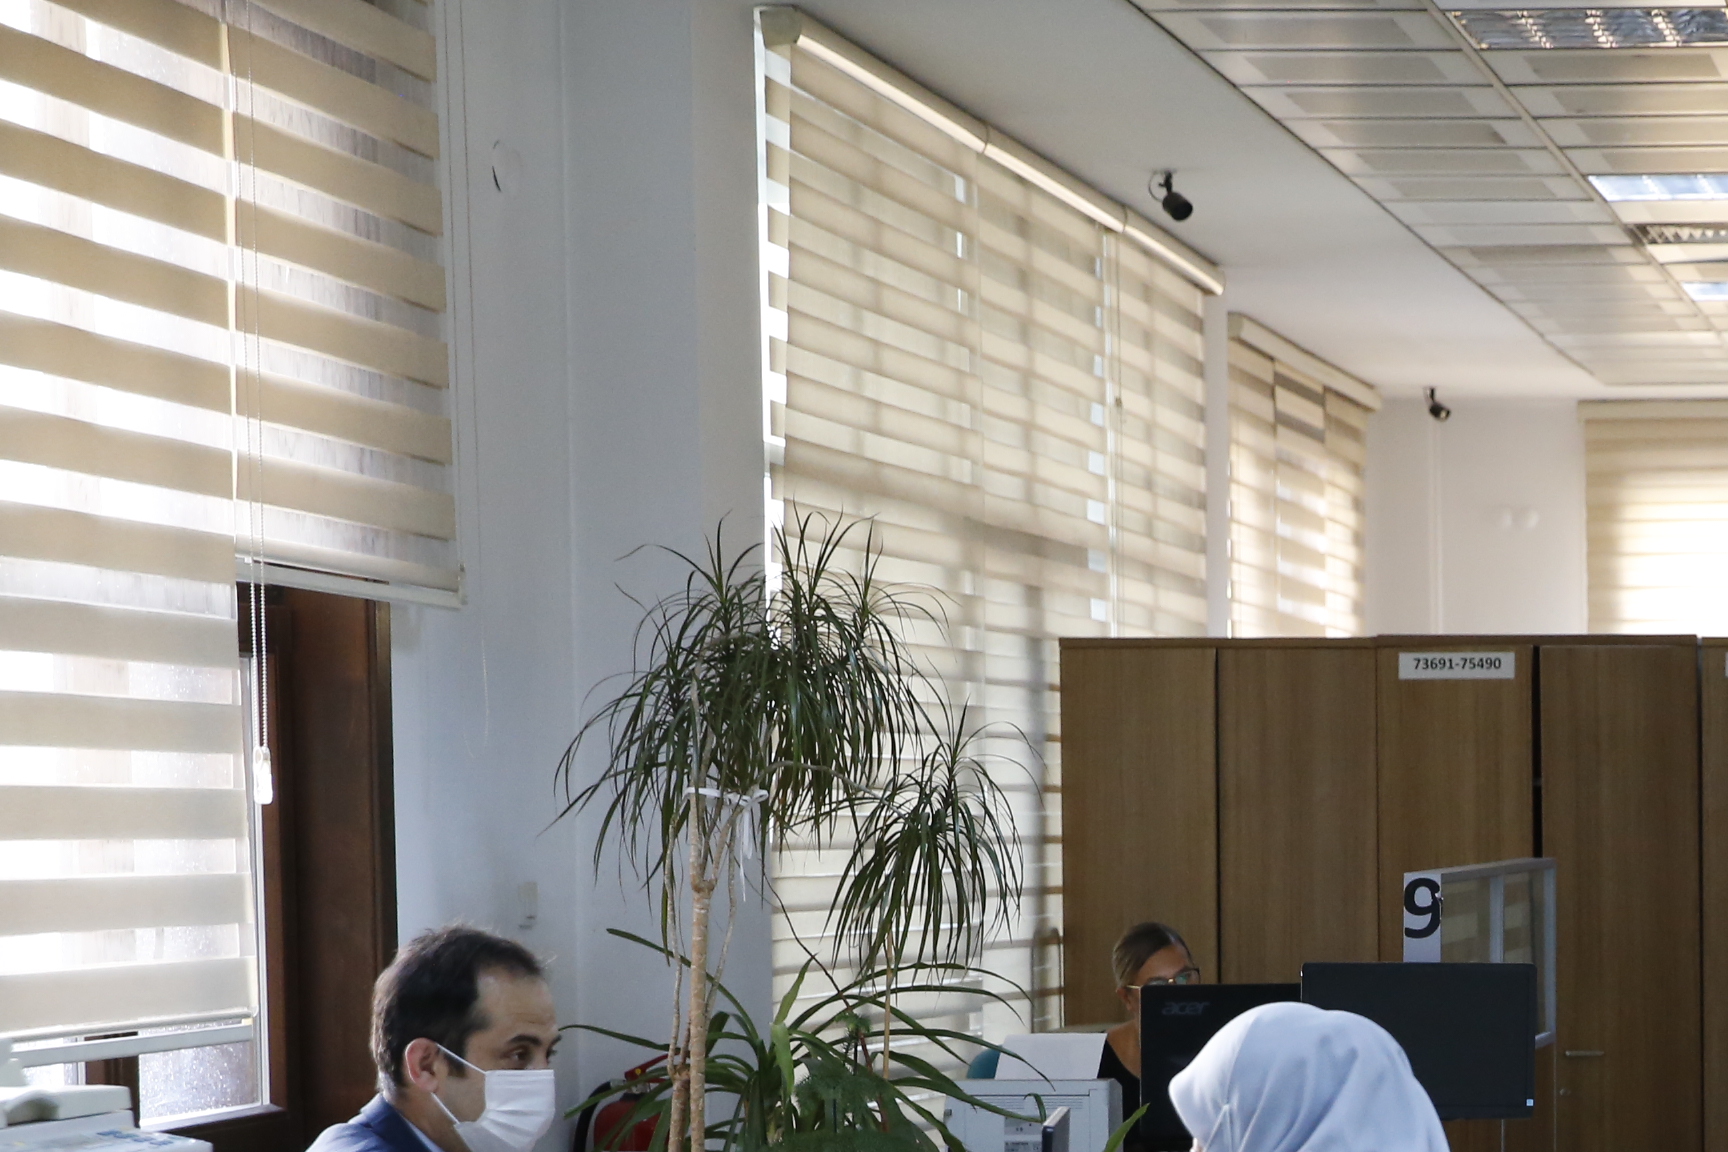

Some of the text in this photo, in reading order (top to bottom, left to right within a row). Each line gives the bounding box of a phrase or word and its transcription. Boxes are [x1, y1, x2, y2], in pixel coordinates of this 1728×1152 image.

[1413, 657, 1502, 670] 73691-75490
[1403, 877, 1441, 939] 9
[1161, 1001, 1211, 1015] acer
